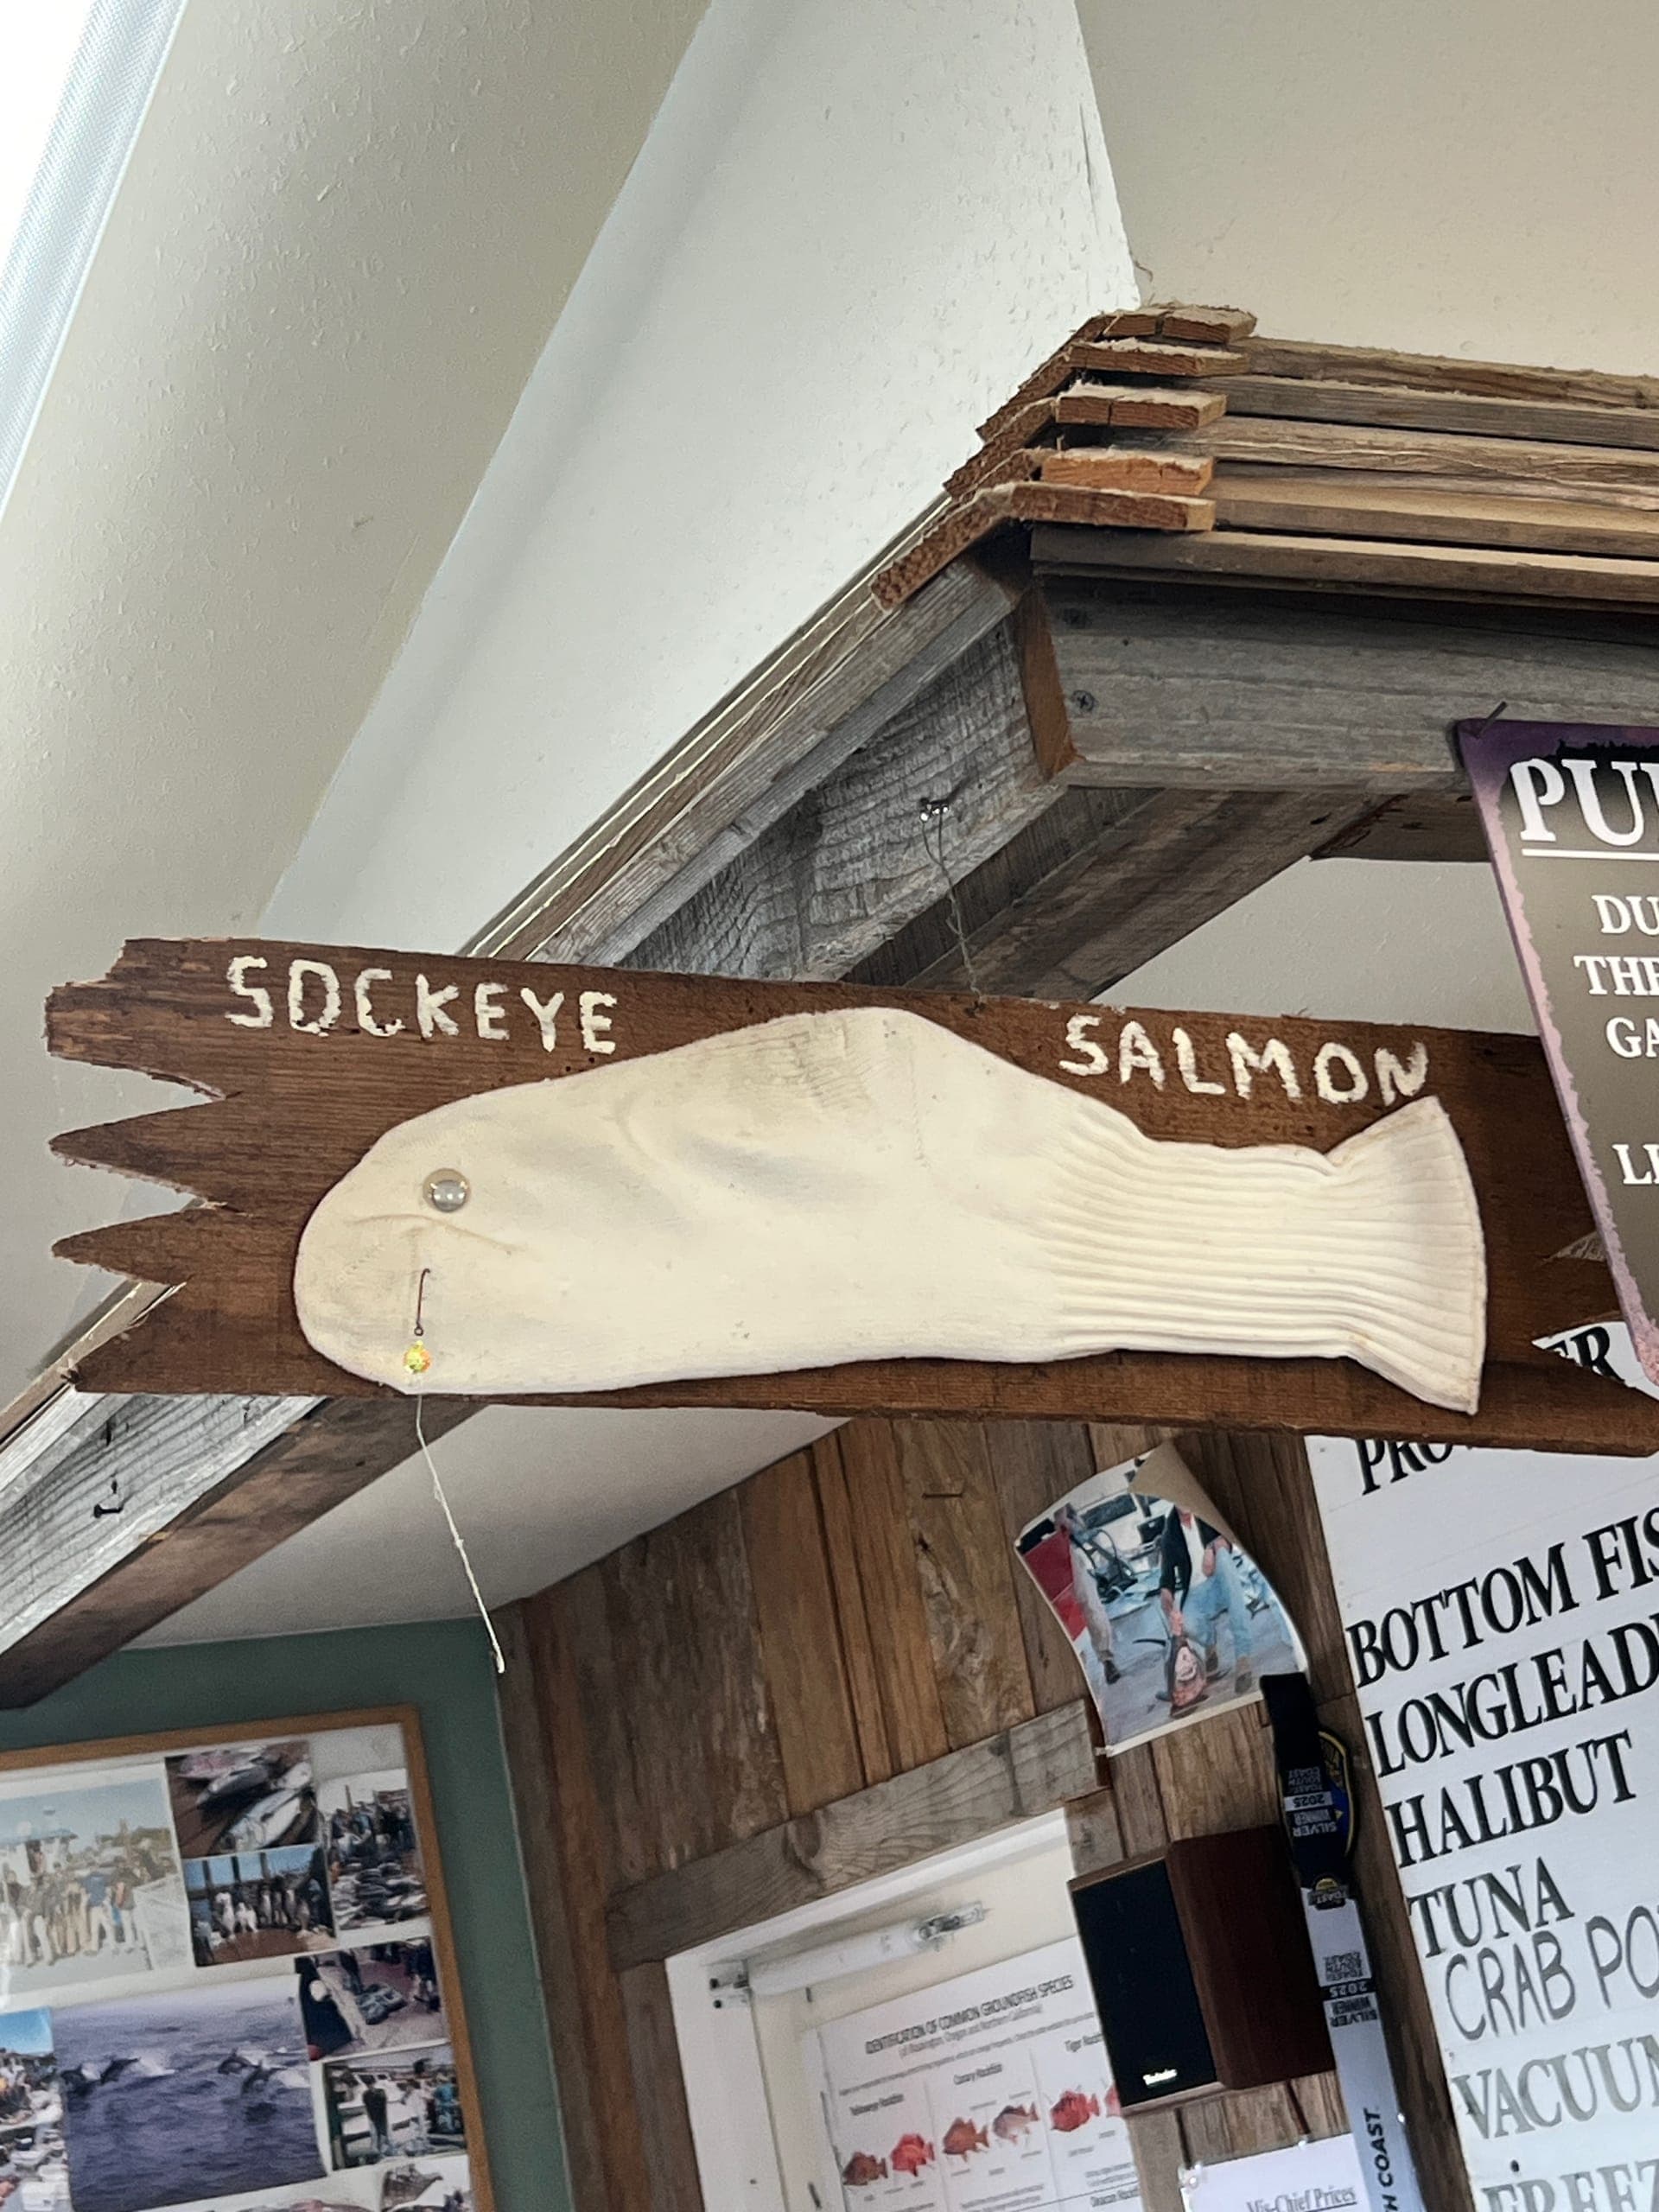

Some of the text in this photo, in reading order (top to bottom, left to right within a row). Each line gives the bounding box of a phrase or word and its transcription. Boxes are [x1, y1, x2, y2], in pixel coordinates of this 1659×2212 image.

[226, 955, 1428, 1107] SOCKEYE SALMON
[1346, 1542, 1580, 1689] BOTTOM
[1364, 1612, 1659, 1779] LONGLEAD
[1292, 1821, 1338, 1838] SILVER
[1293, 1794, 1325, 1808] 2025
[1384, 1730, 1637, 1868] HALIBUT
[1407, 1857, 1574, 1958] TUNA
[1038, 1974, 1074, 1998] SPECIES
[1329, 1981, 1367, 1997] 2025
[1446, 1904, 1659, 2041] CRAB PO
[1330, 2009, 1377, 2028] SILVER
[1363, 2107, 1394, 2188] COAST
[1313, 2184, 1357, 2209] Prices
